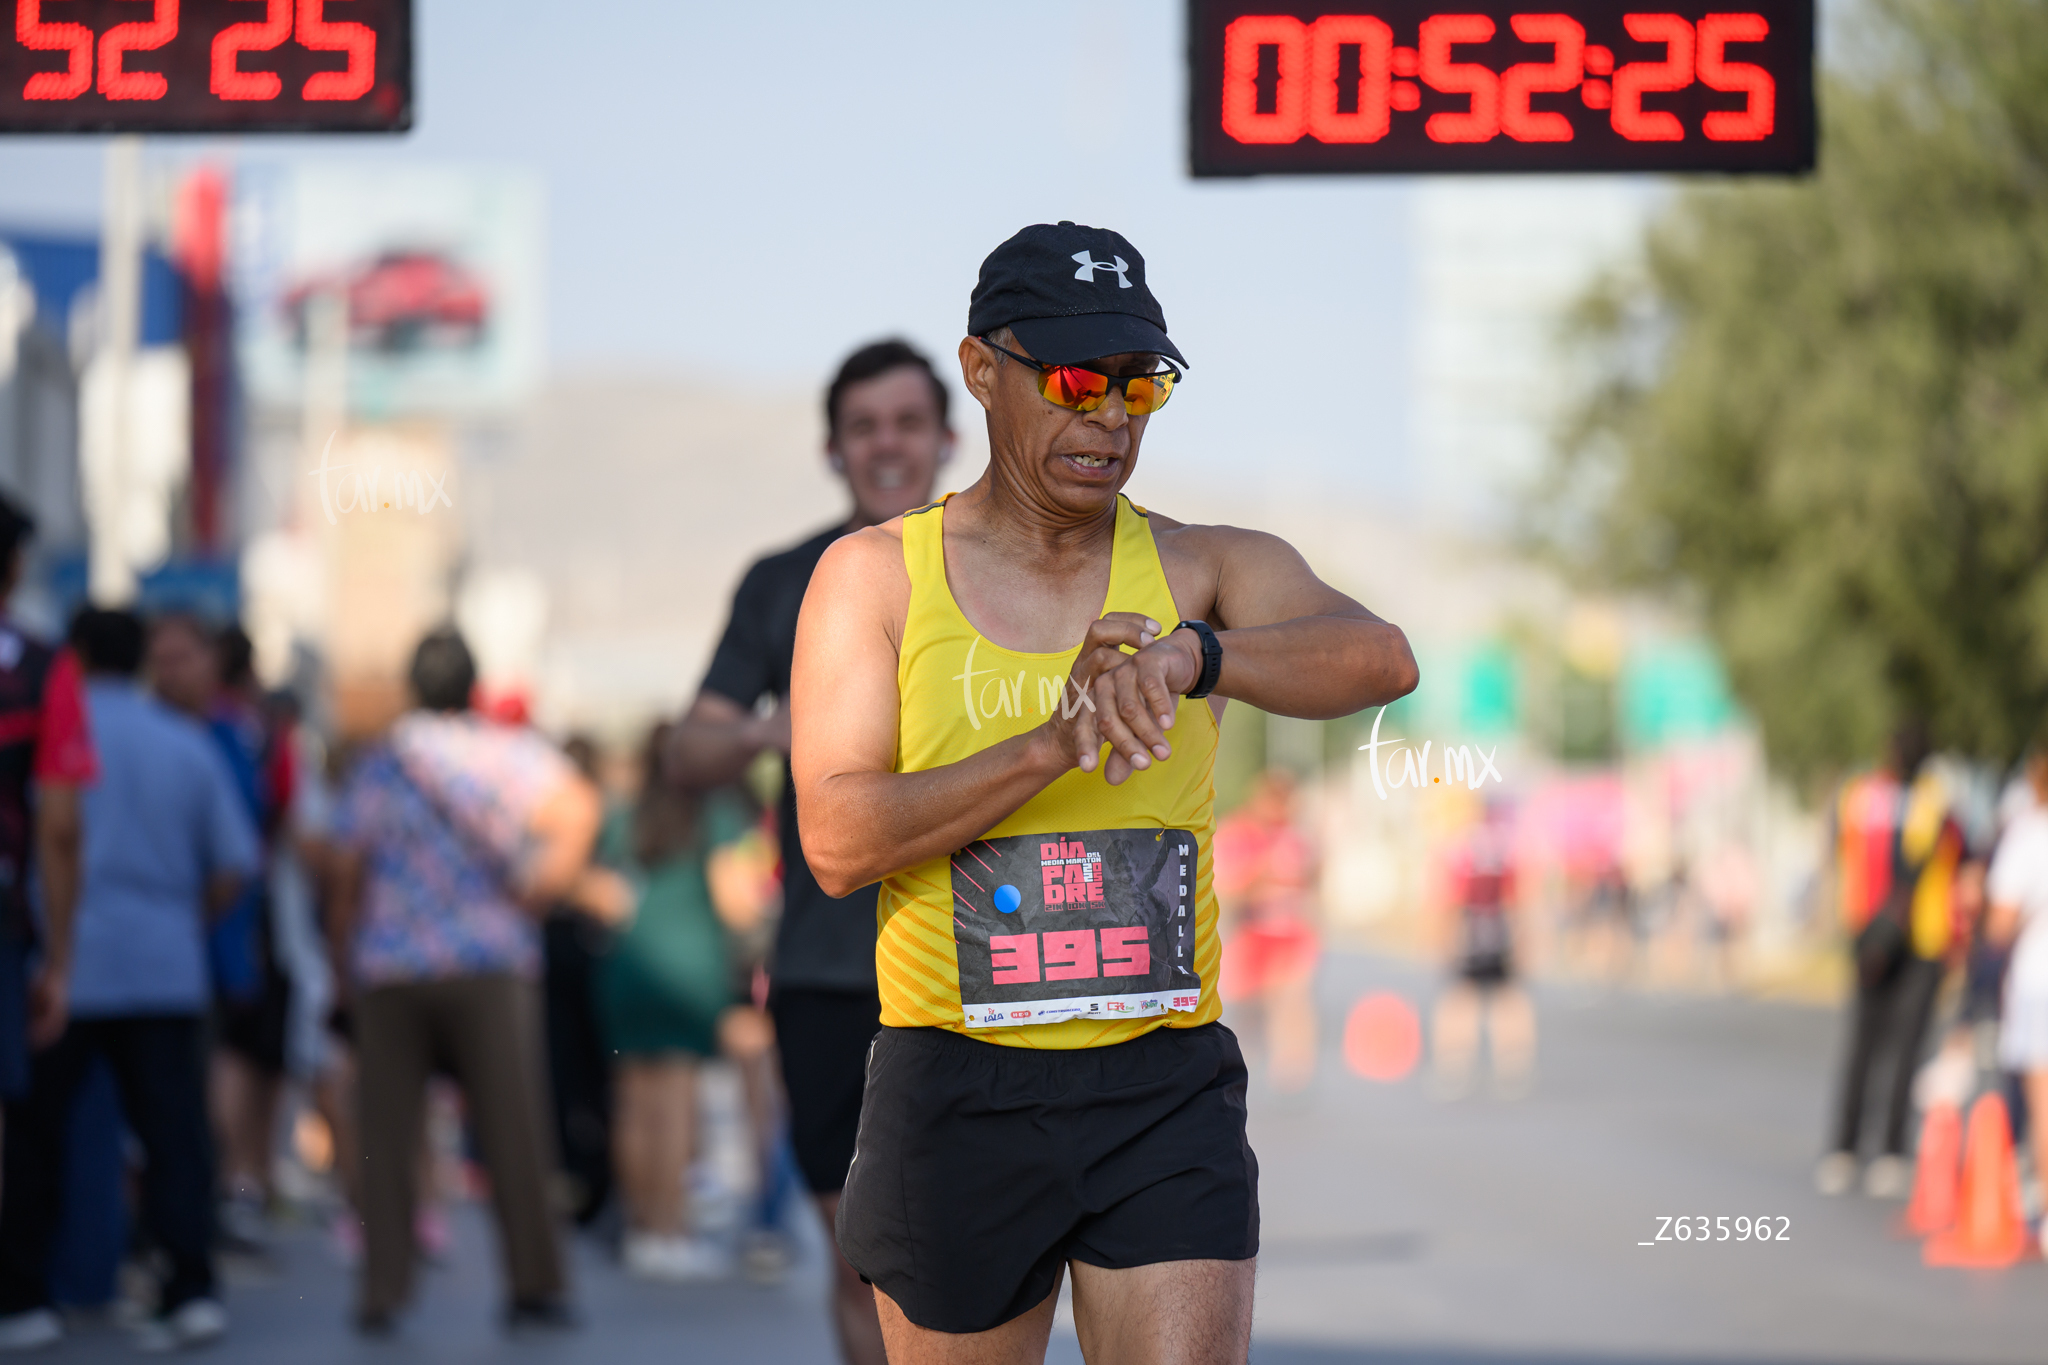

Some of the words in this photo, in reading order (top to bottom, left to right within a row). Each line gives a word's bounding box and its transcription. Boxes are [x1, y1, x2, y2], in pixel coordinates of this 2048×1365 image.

[1221, 13, 1775, 144] 00:52:25
[989, 926, 1150, 985] 395
[984, 1012, 1004, 1023] LALA
[1173, 996, 1198, 1007] 395
